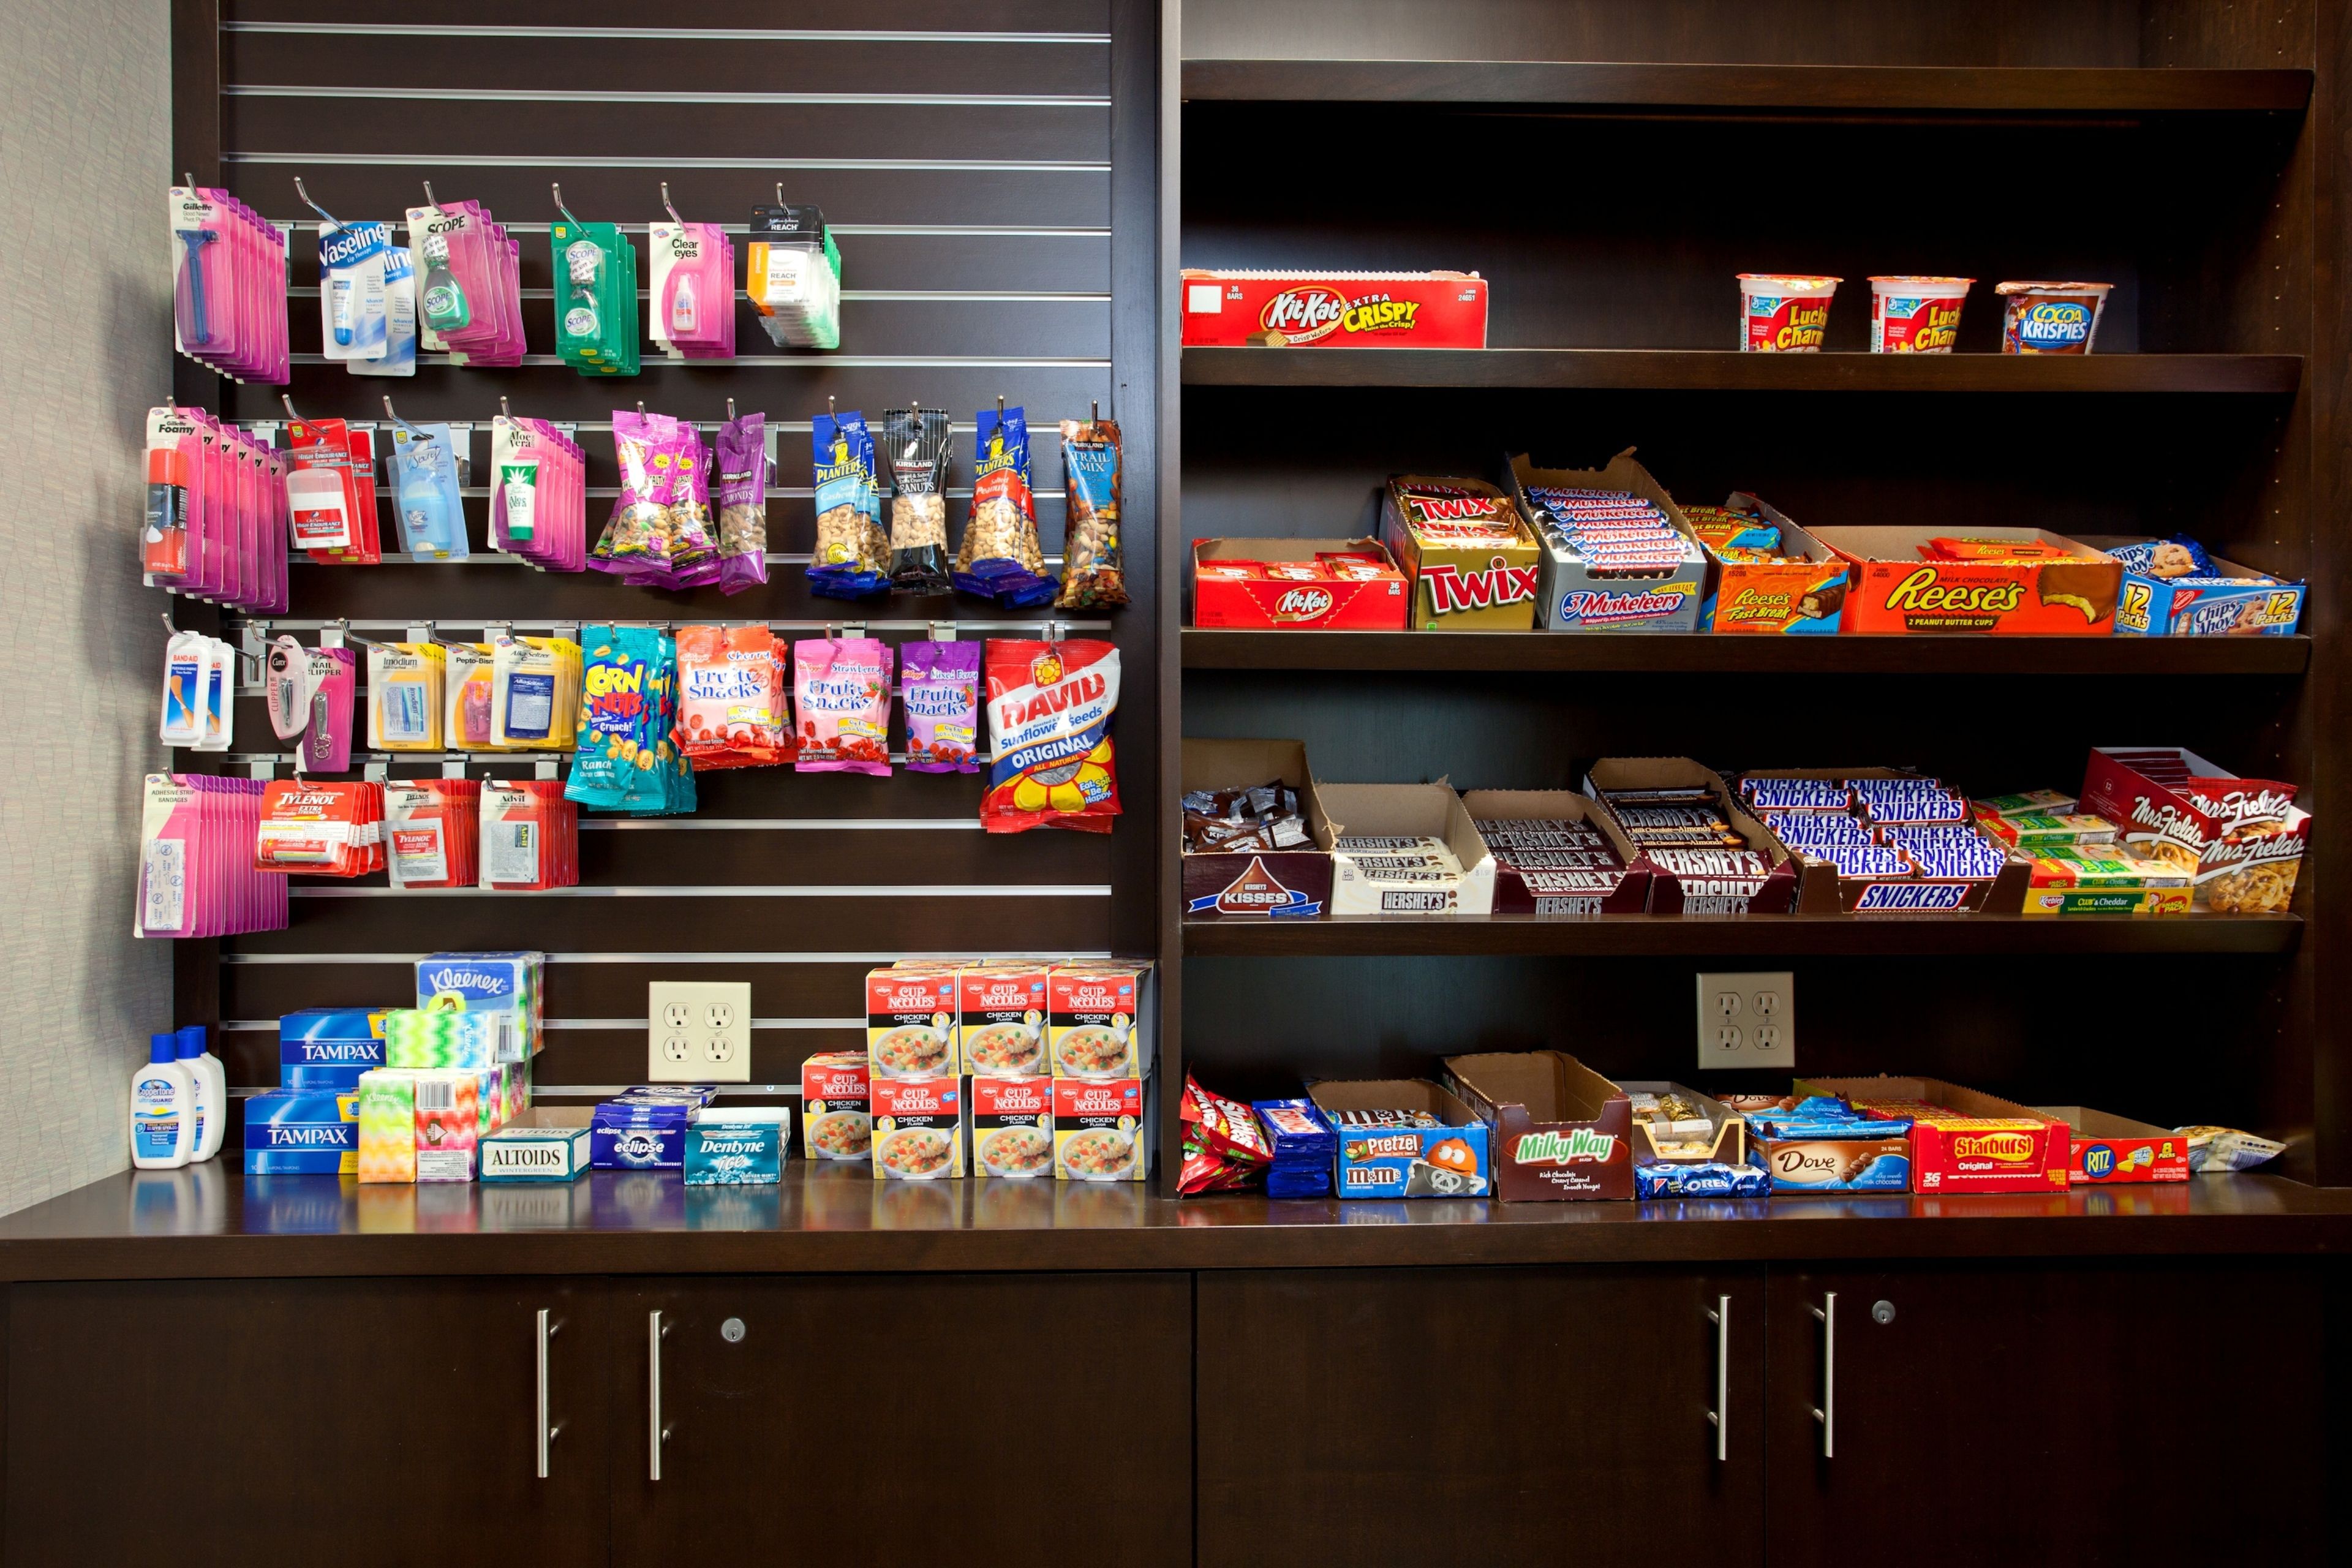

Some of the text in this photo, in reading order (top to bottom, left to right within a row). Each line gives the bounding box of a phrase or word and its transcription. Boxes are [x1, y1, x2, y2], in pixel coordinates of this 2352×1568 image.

[428, 216, 466, 233] SCOPE
[320, 224, 384, 266] Vaseline
[672, 239, 698, 249] Clear
[355, 248, 372, 258] Therapy
[674, 249, 698, 258] eyes
[426, 293, 450, 307] SCOPE
[1344, 293, 1390, 311] EXTRA
[1343, 301, 1420, 333] CRISPY
[2032, 306, 2082, 323] COCOA
[1389, 319, 1415, 329] Crisp!
[2022, 320, 2087, 339] KRISPIES
[1294, 326, 1331, 342] Crisp Wafers
[159, 424, 195, 435] Foamy
[510, 431, 532, 441] Aloe
[510, 439, 532, 448] Vera
[1073, 451, 1110, 462] TRAIL
[817, 461, 861, 483] PLANTERS
[1080, 462, 1105, 472] MIX
[722, 471, 752, 480] KIRKLAND
[898, 482, 934, 494] PEANUTS
[976, 483, 1009, 494] Peanuts
[1574, 510, 1659, 520] Musketeers
[1977, 545, 2005, 556] Reese's
[1683, 584, 1692, 592] FAT
[1885, 567, 2027, 611] Reese's
[1565, 591, 1681, 617] 3 Musketeers
[1735, 589, 1791, 605] Reese's
[2123, 584, 2151, 616] 12
[2265, 592, 2297, 616] 12
[1727, 608, 1791, 621] Fast Break
[2117, 612, 2149, 628] Packs
[2195, 601, 2236, 625] Chips
[2255, 612, 2295, 625] Packs
[383, 657, 417, 666] Imodium
[728, 652, 771, 660] Cherry
[832, 663, 881, 674] Strawberry
[930, 671, 978, 680] Mixed Berry
[586, 665, 644, 696] CORN
[688, 683, 761, 700] Snacks
[809, 680, 867, 696] Fruity
[910, 686, 965, 702] Fruity
[593, 692, 644, 717] NUTS
[1001, 673, 1106, 730] DAVID
[905, 703, 968, 715] Snacks
[591, 714, 612, 723] Ultimate
[1033, 719, 1052, 728] Roasted
[600, 722, 632, 733] Crunch!
[1012, 734, 1094, 769] ORIGINAL
[582, 760, 612, 770] Ranch
[1033, 754, 1080, 772] ALL NATURAL
[1080, 776, 1112, 791] Eat. Spit.
[281, 793, 334, 805] TYLENOL
[1085, 791, 1112, 804] Happy.
[1756, 790, 1849, 807] SNICKERS
[1871, 801, 1961, 821] SNICKERS
[2132, 796, 2164, 827] Mrs.
[2151, 805, 2205, 847] Fields
[1224, 893, 1287, 903] KISSES
[1384, 892, 1444, 910] HERSHEY'S
[1859, 885, 1965, 908] SNICKERS
[2039, 896, 2064, 905] Keebler
[429, 968, 503, 994] Kleenex
[899, 986, 927, 997] CUP
[888, 995, 937, 1008] NOODLES
[302, 1046, 380, 1060] TAMPAX
[832, 1074, 858, 1085] CUP
[138, 1087, 175, 1097] Coppertone
[822, 1082, 867, 1096] NOODLES
[902, 1088, 930, 1099] CUP
[366, 1093, 399, 1104] Kleenex
[891, 1098, 938, 1110] NOODLES
[267, 1129, 348, 1145] TAMPAX
[614, 1140, 665, 1154] eclipse
[699, 1140, 764, 1154] Dentyne
[1367, 1134, 1419, 1155] Pretzel
[1517, 1130, 1614, 1164] Milky Way
[1955, 1136, 2034, 1155] Starburst
[2162, 1143, 2172, 1153] 8
[492, 1149, 560, 1165] ALTOIDS
[718, 1155, 745, 1172] ice
[1777, 1151, 1835, 1173] Dove
[2087, 1150, 2111, 1172] RITZ
[1687, 1178, 1729, 1191] OREO
[1923, 1172, 1941, 1183] 36
